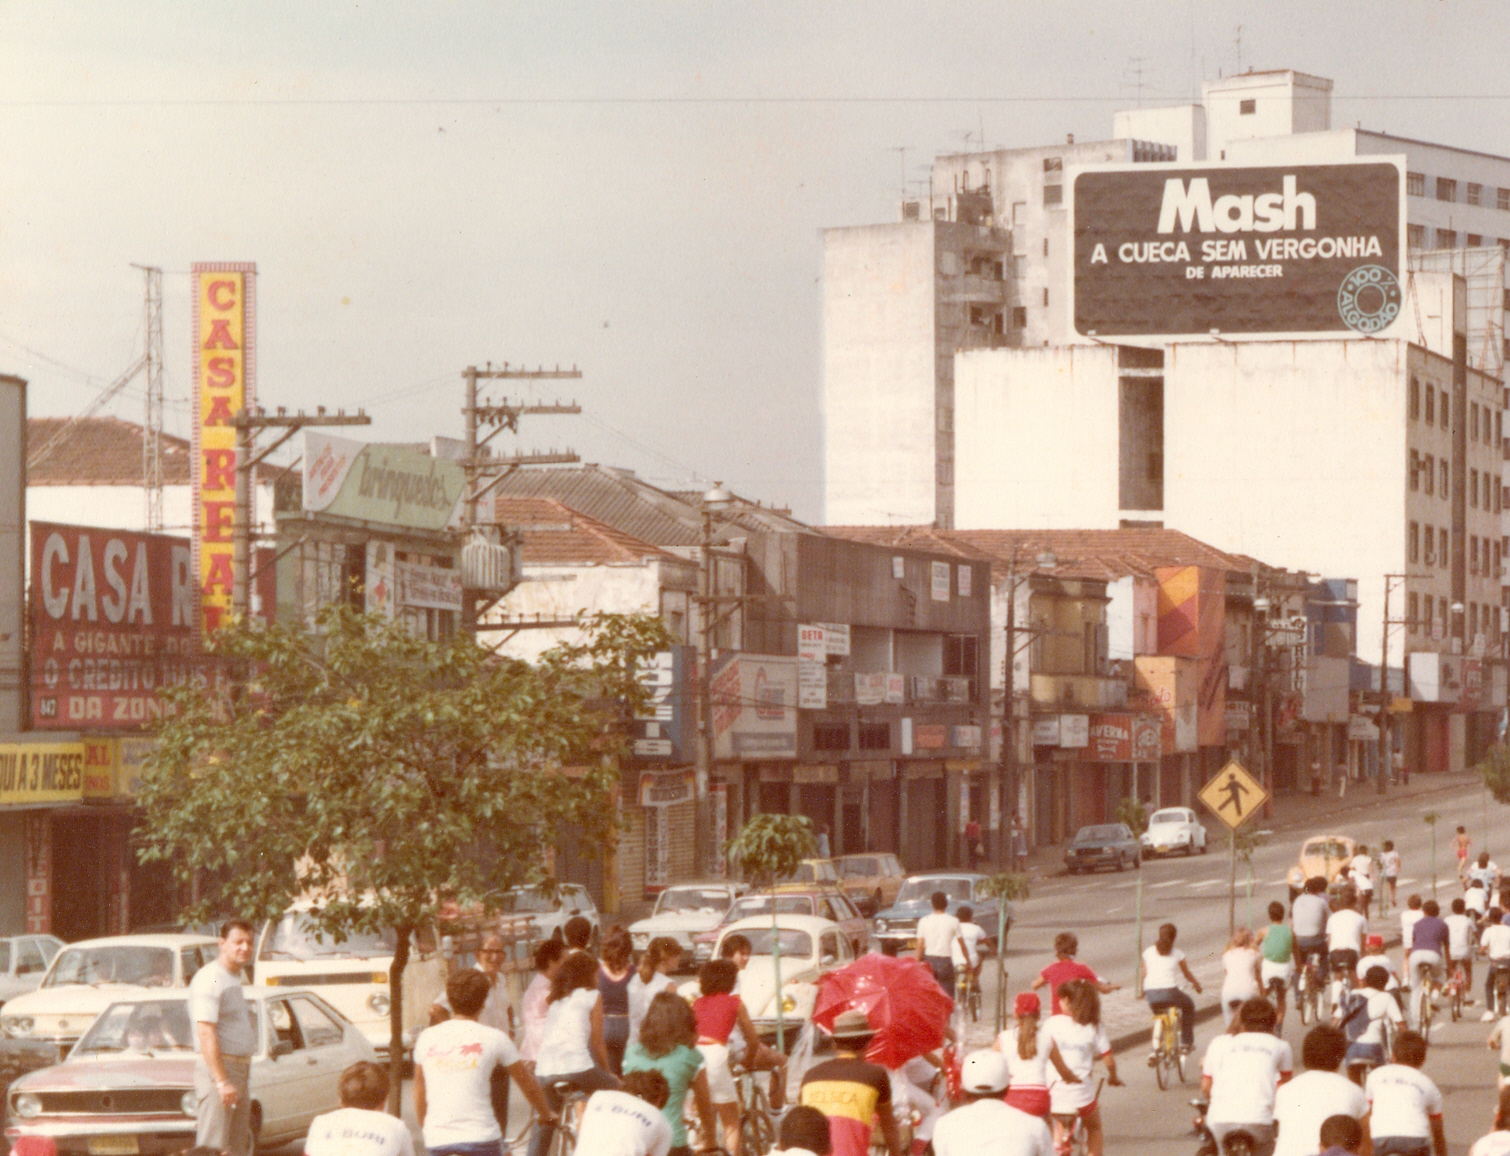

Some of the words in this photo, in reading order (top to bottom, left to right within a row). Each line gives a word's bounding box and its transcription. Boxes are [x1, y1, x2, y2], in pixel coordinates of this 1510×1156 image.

[1158, 175, 1316, 234] Mash
[1091, 244, 1108, 264] A
[1118, 241, 1190, 263] CUECA
[1202, 240, 1247, 261] SEM
[1255, 236, 1382, 260] VERGONHA
[1186, 266, 1204, 279] DE
[1212, 264, 1283, 279] APARECER
[204, 280, 239, 428] CASA
[41, 533, 153, 624] CASA
[69, 696, 103, 720] DA
[30, 753, 39, 790] 3
[42, 753, 82, 790] MESES
